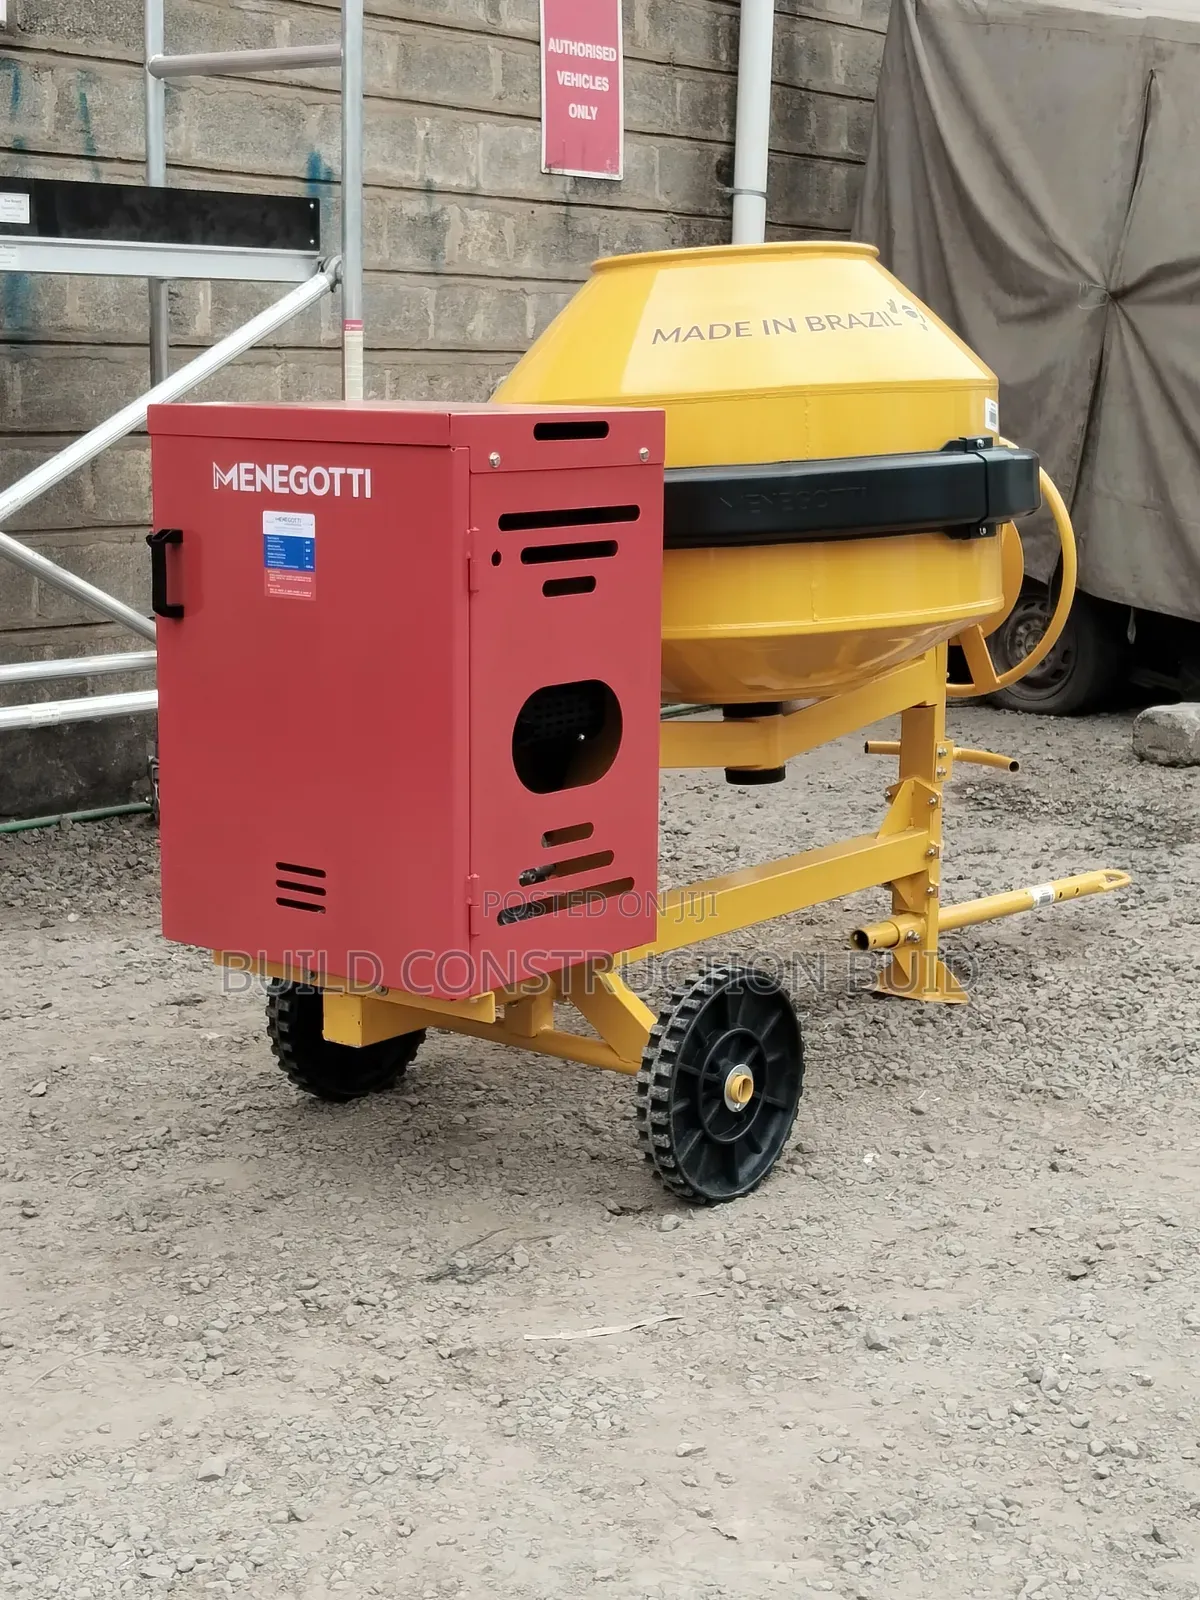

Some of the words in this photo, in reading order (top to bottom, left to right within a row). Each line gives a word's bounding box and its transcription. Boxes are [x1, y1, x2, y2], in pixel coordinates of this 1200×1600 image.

[547, 37, 617, 62] AUTHORISED
[556, 69, 610, 92] VEHICLES
[568, 102, 599, 121] ONLY
[651, 320, 753, 345] MADE
[762, 317, 797, 336] IN
[804, 311, 903, 333] BRAZIL
[212, 461, 372, 499] MENEGOTTI
